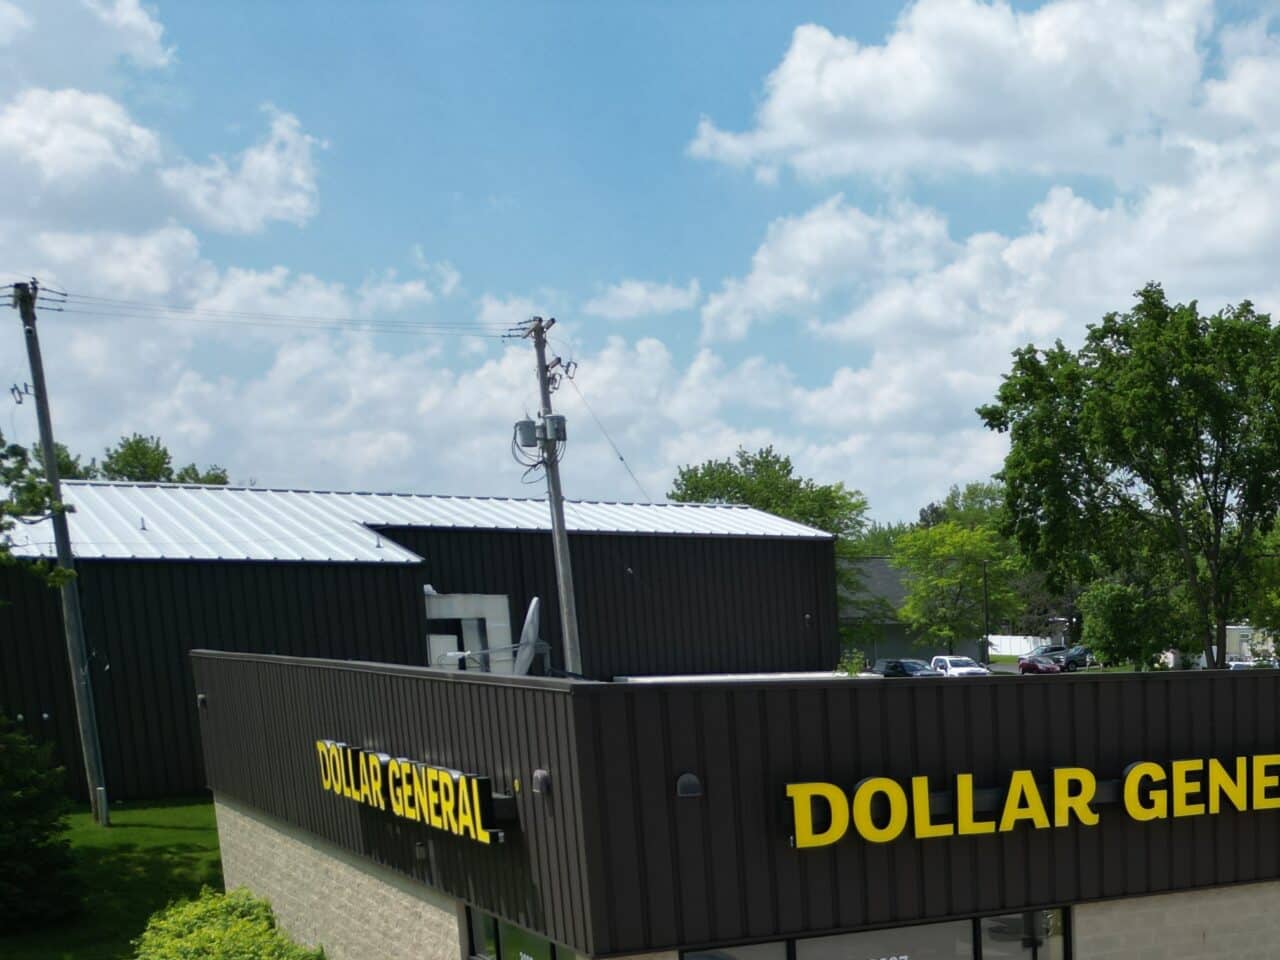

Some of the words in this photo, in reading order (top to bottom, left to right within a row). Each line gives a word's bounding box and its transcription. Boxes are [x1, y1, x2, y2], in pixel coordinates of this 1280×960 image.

[316, 740, 386, 811] DOLLAR
[388, 758, 491, 845] GENERAL
[786, 767, 1100, 849] DOLLAR
